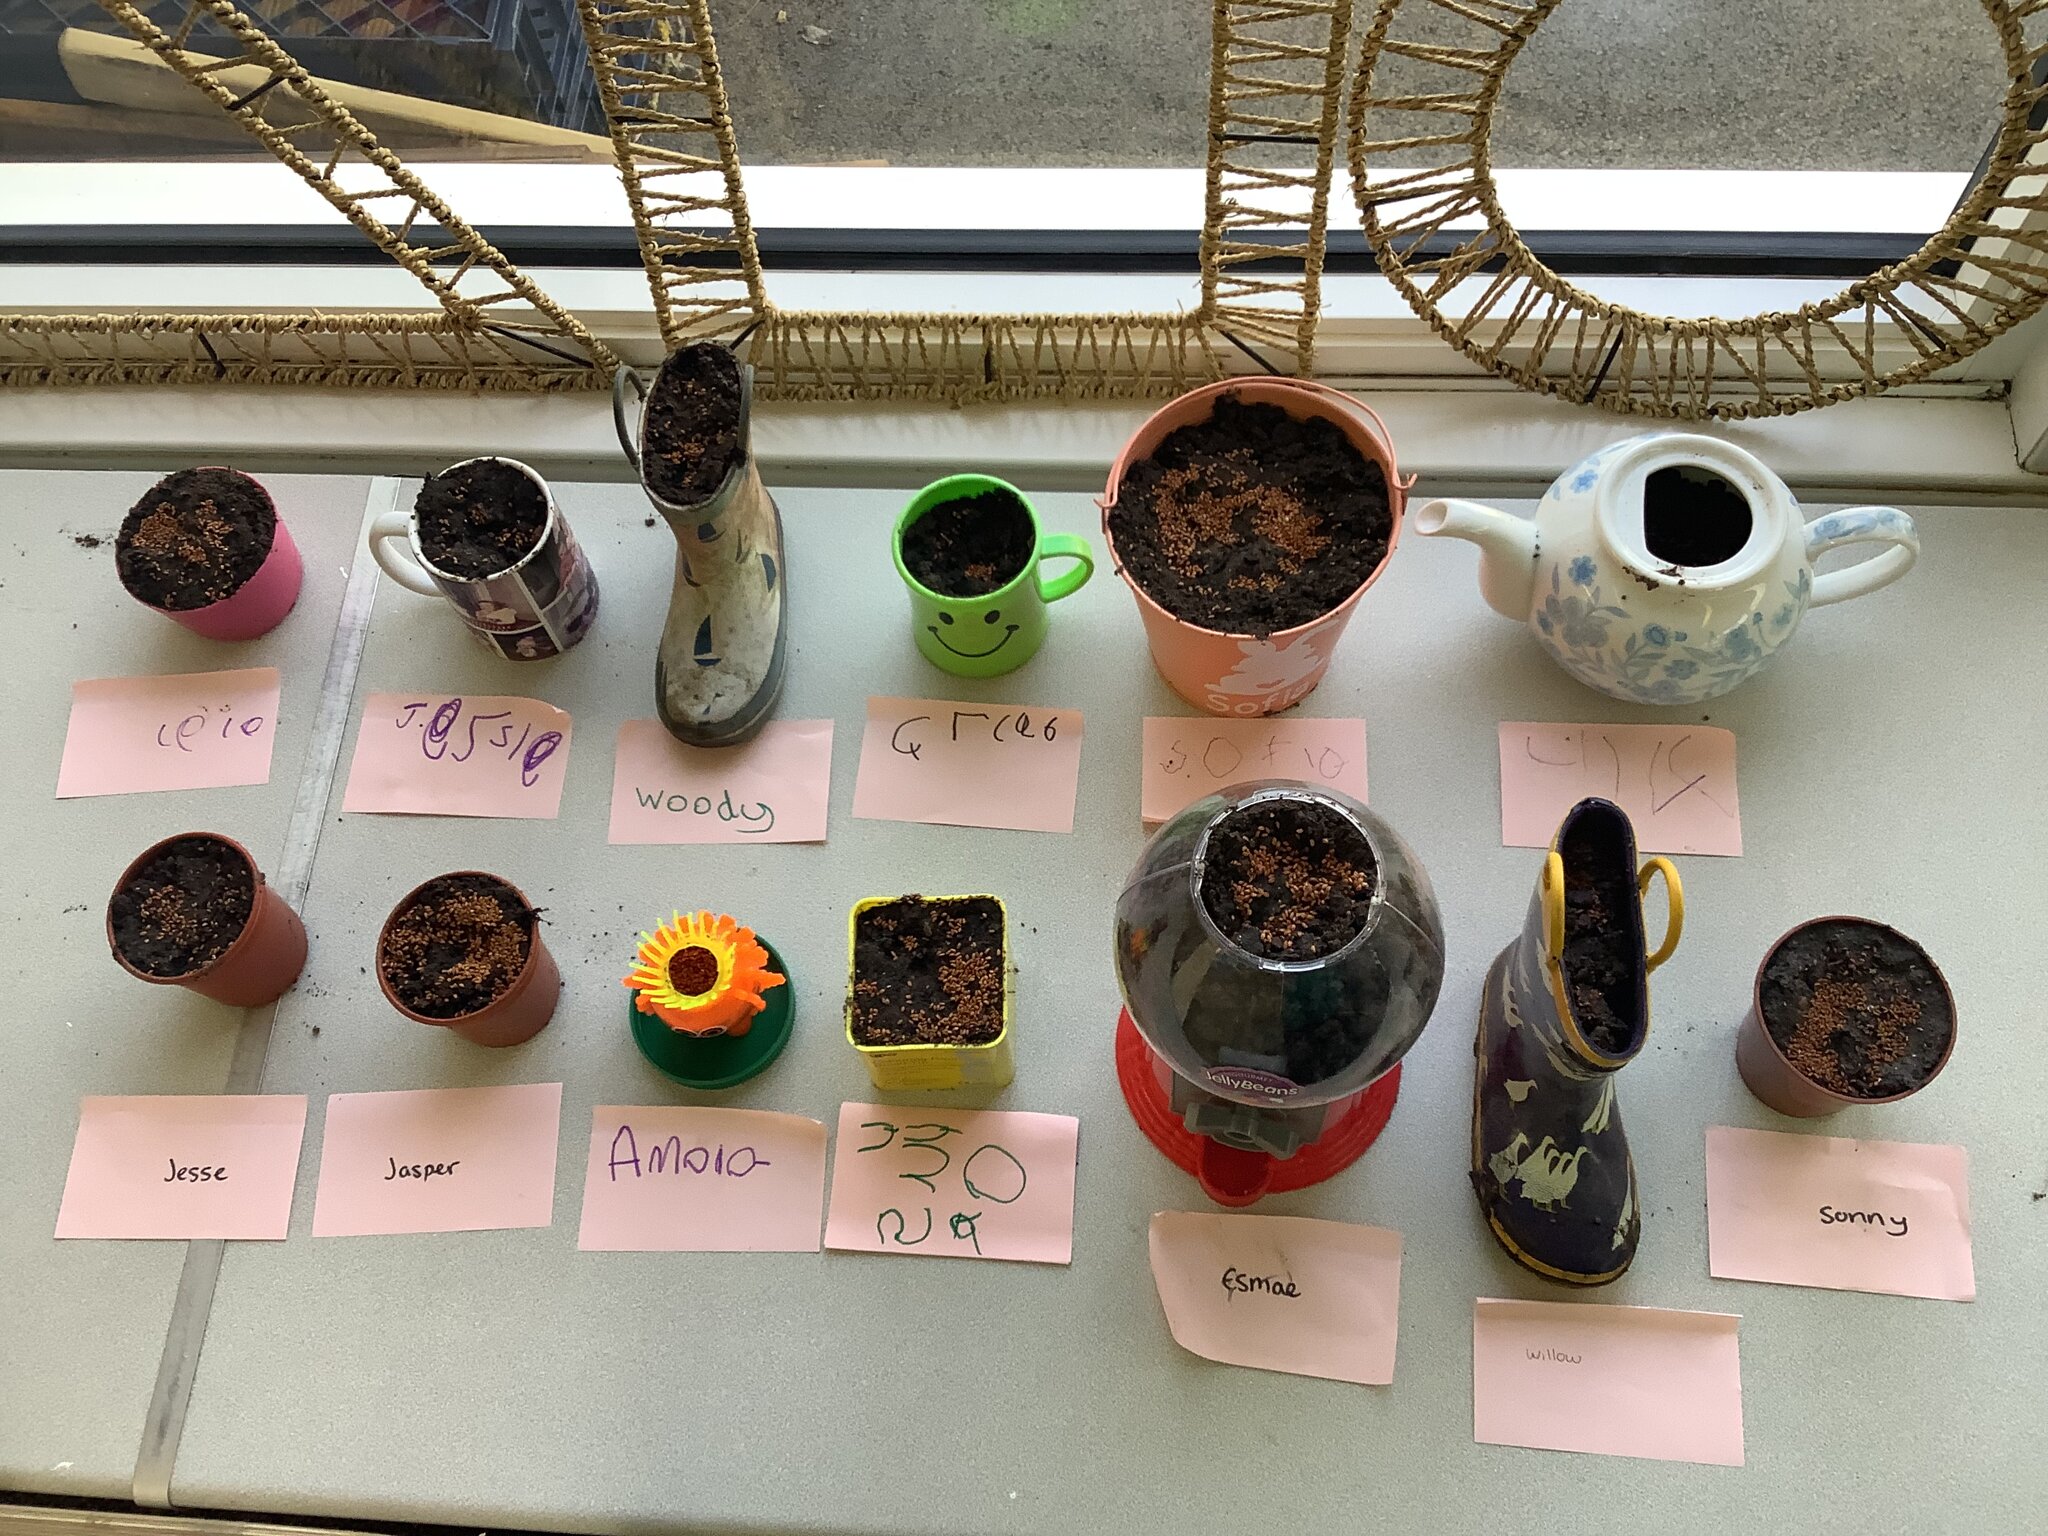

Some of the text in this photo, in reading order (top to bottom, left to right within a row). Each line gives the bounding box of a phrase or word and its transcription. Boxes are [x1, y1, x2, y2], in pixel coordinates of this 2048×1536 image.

[1206, 1070, 1299, 1096] JellyBeans
[163, 1158, 229, 1184] Jesse
[384, 1157, 461, 1182] Jasper
[1819, 1204, 1909, 1237] Sonny
[1222, 1266, 1302, 1299] Esmae
